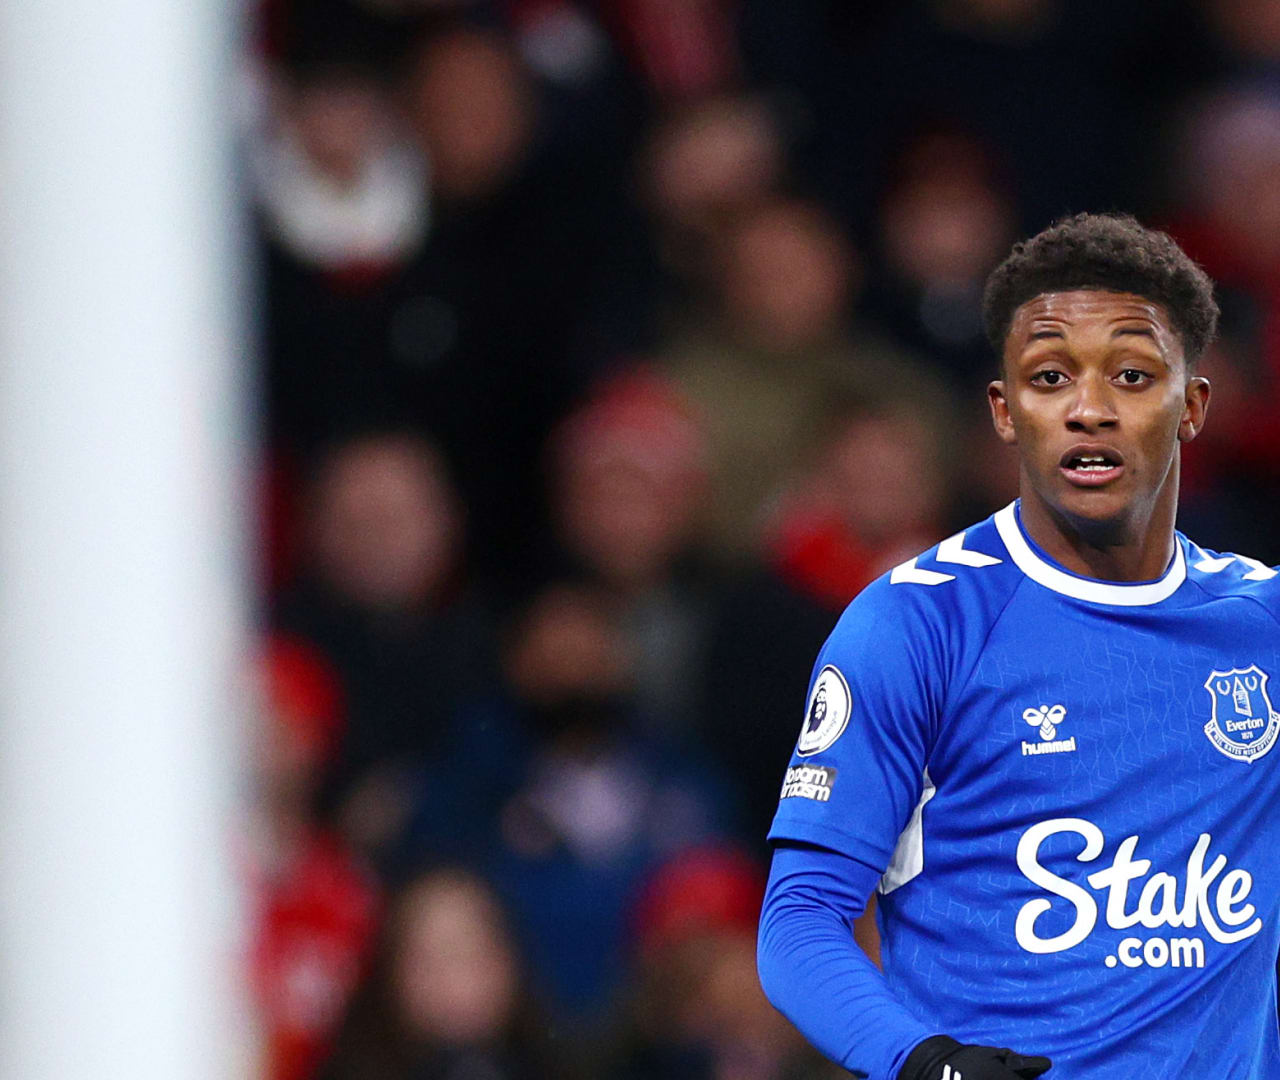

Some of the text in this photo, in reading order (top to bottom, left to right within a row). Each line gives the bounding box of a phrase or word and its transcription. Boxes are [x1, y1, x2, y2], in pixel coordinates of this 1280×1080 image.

[1226, 718, 1264, 732] Everton
[1021, 736, 1076, 756] hummel
[1015, 817, 1262, 954] Stake
[1104, 937, 1205, 968] .com
